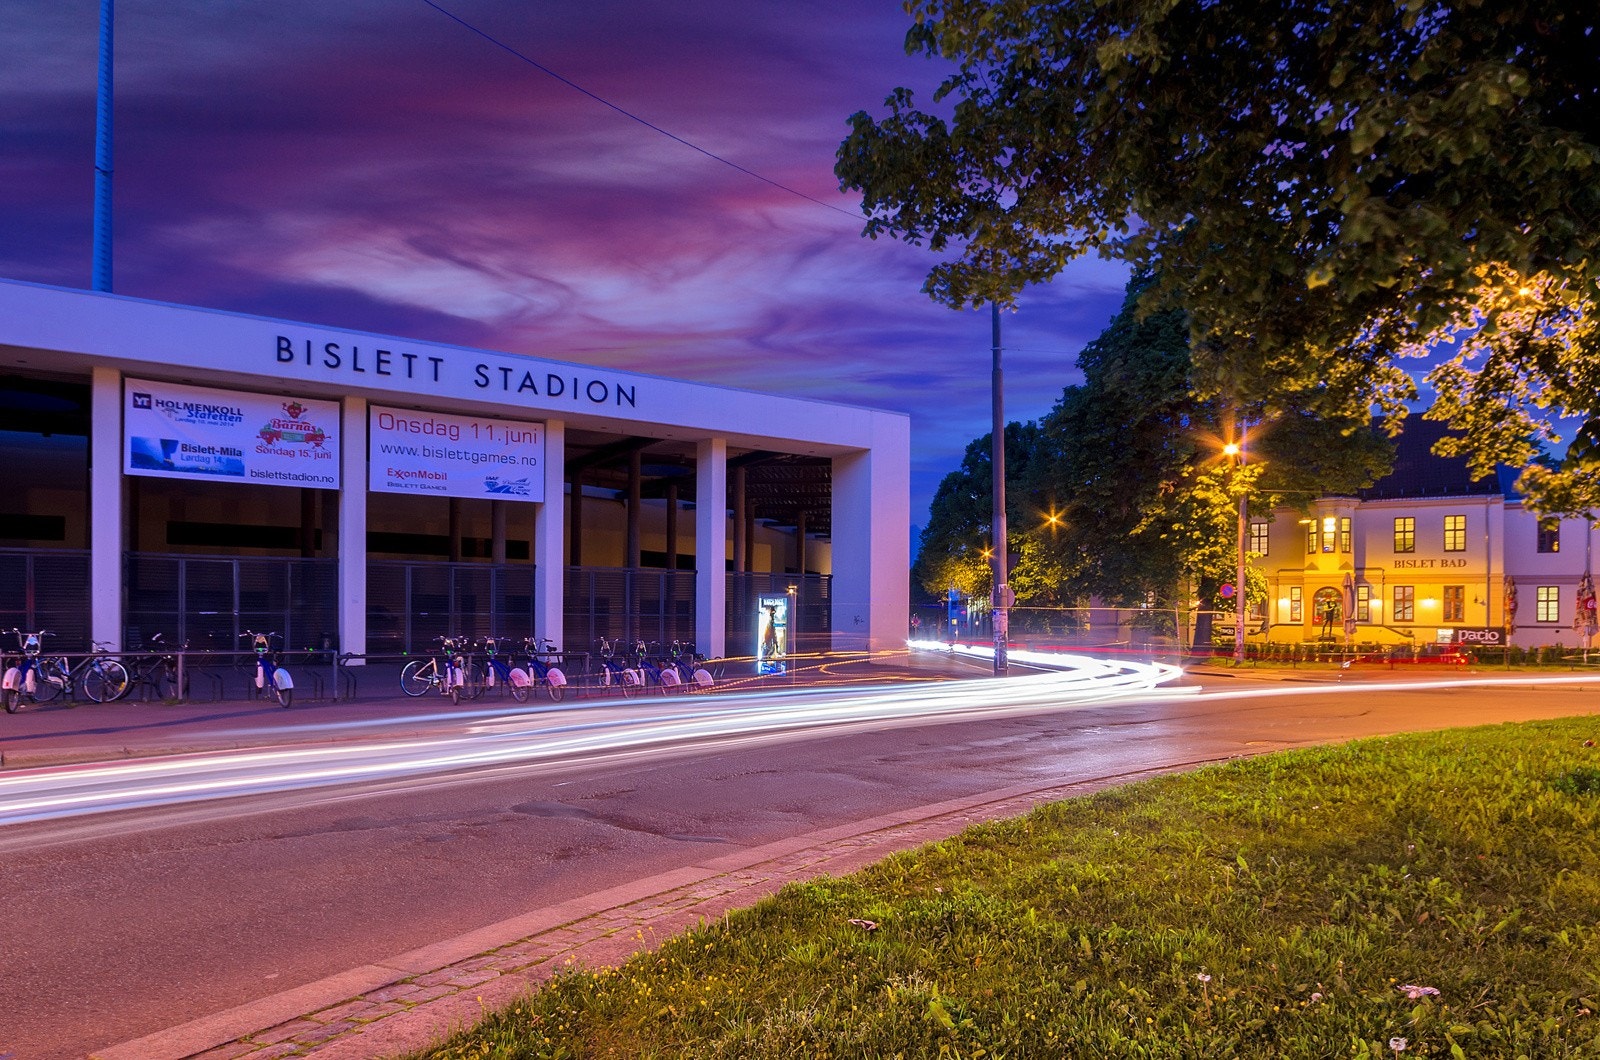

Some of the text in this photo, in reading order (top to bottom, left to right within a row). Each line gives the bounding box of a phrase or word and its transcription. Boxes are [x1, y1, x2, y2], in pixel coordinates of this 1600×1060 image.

[276, 335, 636, 408] BISLETT STADION
[155, 399, 243, 416] HOLMENKOLL
[187, 410, 242, 422] Stafetten
[270, 418, 317, 432] Barnas
[379, 412, 460, 441] Onsdag
[181, 443, 243, 457] Bislett-Mila
[255, 445, 332, 460] Søndag 15. juni
[380, 443, 537, 467] www.bislettgames.no
[180, 453, 211, 465] Lørdag
[250, 468, 335, 483] bislettstadion.no
[387, 467, 448, 480] ExxonMobil
[387, 481, 447, 491] BISLETT GAMES
[1394, 559, 1467, 569] BISLET BAD
